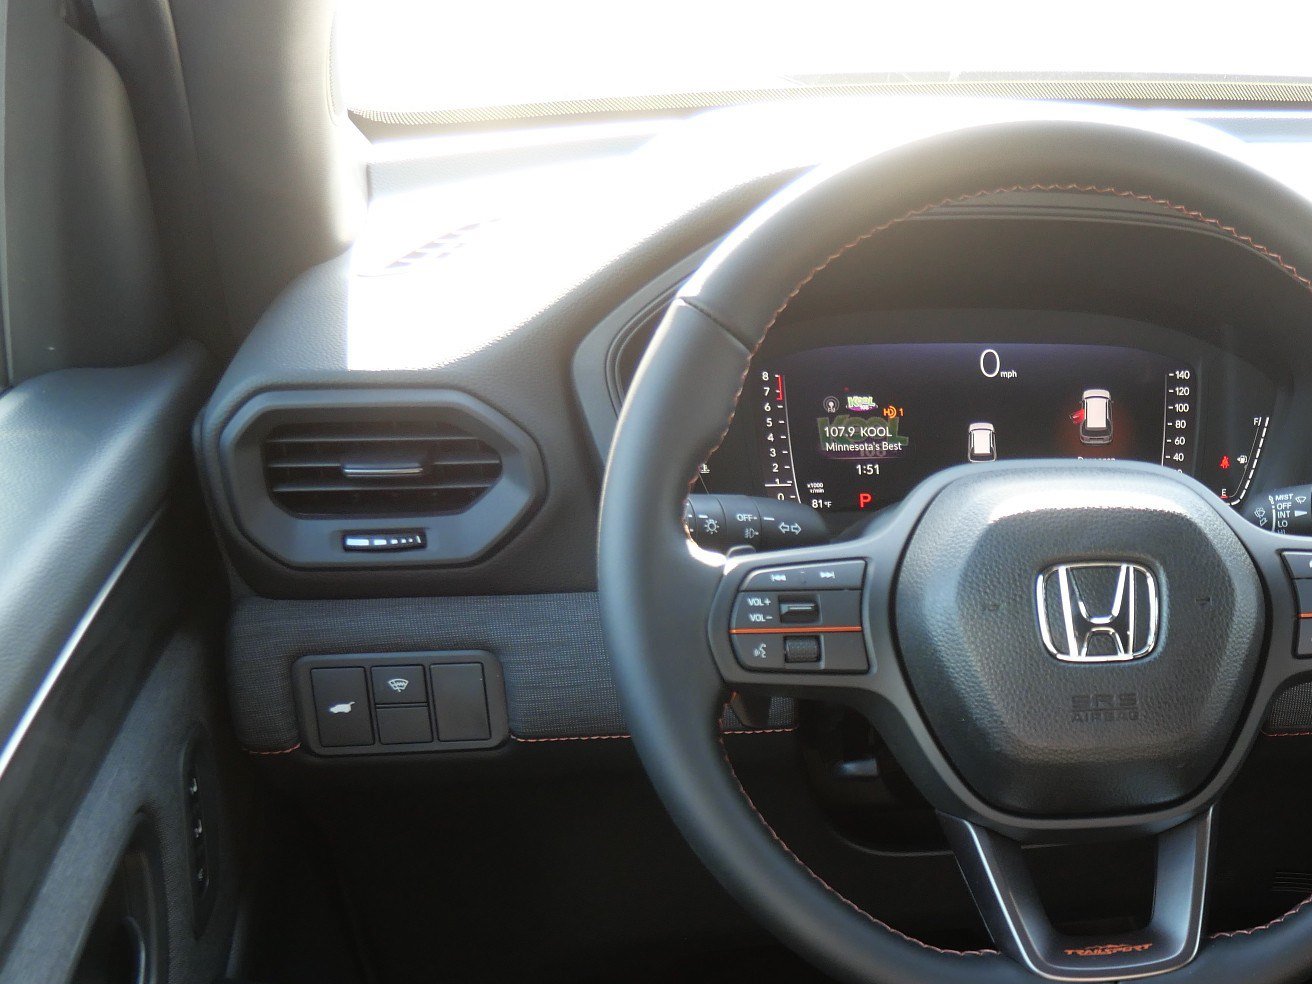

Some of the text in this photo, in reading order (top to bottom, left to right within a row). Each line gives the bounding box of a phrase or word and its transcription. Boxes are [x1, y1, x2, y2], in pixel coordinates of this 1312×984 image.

[980, 349, 1017, 379] 0 mph
[762, 372, 769, 381] 8
[1175, 370, 1190, 379] 140
[764, 387, 770, 396] 7
[1175, 386, 1190, 396] 120
[764, 402, 771, 412] 6
[1174, 403, 1189, 412] 100
[766, 418, 773, 427] 5
[1175, 420, 1187, 429] 80
[1253, 418, 1259, 426] F
[824, 426, 892, 437] 107.9 KOOL
[767, 433, 774, 442] 4
[1174, 436, 1186, 445] 60
[826, 441, 902, 451] Minnesota's Best
[770, 448, 776, 457] 3
[1173, 452, 1184, 462] 40
[772, 463, 779, 472] 2
[856, 464, 880, 475] 1:51
[777, 492, 785, 501] 0
[859, 494, 872, 508] P
[1275, 493, 1293, 501] MIST
[1276, 502, 1292, 510] OFF
[1277, 510, 1291, 518] INT
[1277, 520, 1288, 528] LO
